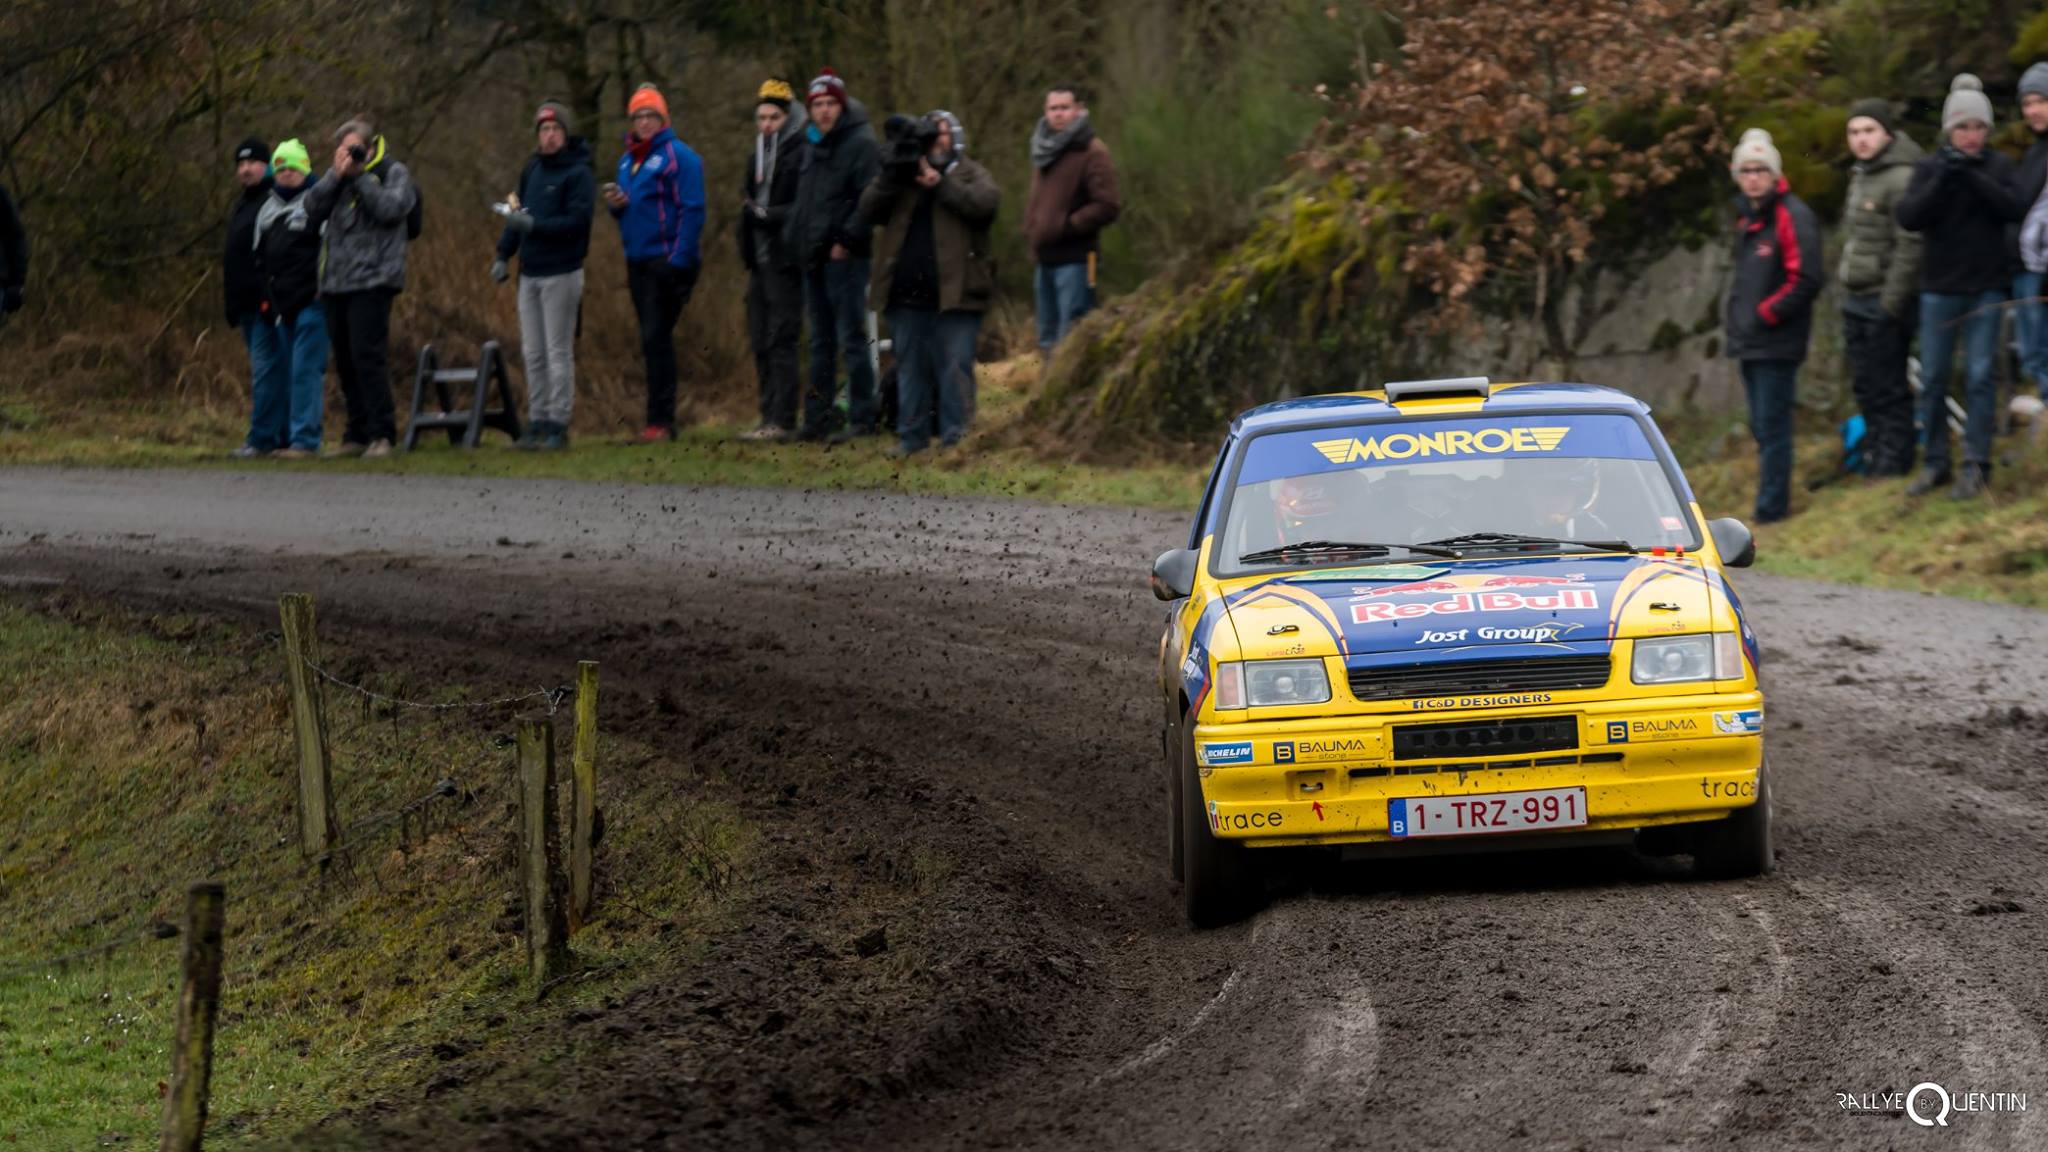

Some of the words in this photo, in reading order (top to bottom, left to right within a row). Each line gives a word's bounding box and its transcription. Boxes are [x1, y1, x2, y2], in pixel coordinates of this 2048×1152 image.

[1346, 428, 1541, 463] MONROE
[1353, 593, 1474, 623] Red
[1479, 590, 1598, 611] Bull
[1416, 628, 1468, 643] Jost
[1478, 626, 1552, 643] Group
[1427, 699, 1455, 708] C&D
[1460, 694, 1552, 707] DESIGNERS
[1633, 719, 1697, 733] BAUMA
[1300, 740, 1366, 753] BAUMA
[1218, 809, 1283, 831] trace
[1415, 794, 1576, 830] 1-TRZ-991
[1392, 821, 1404, 833] B
